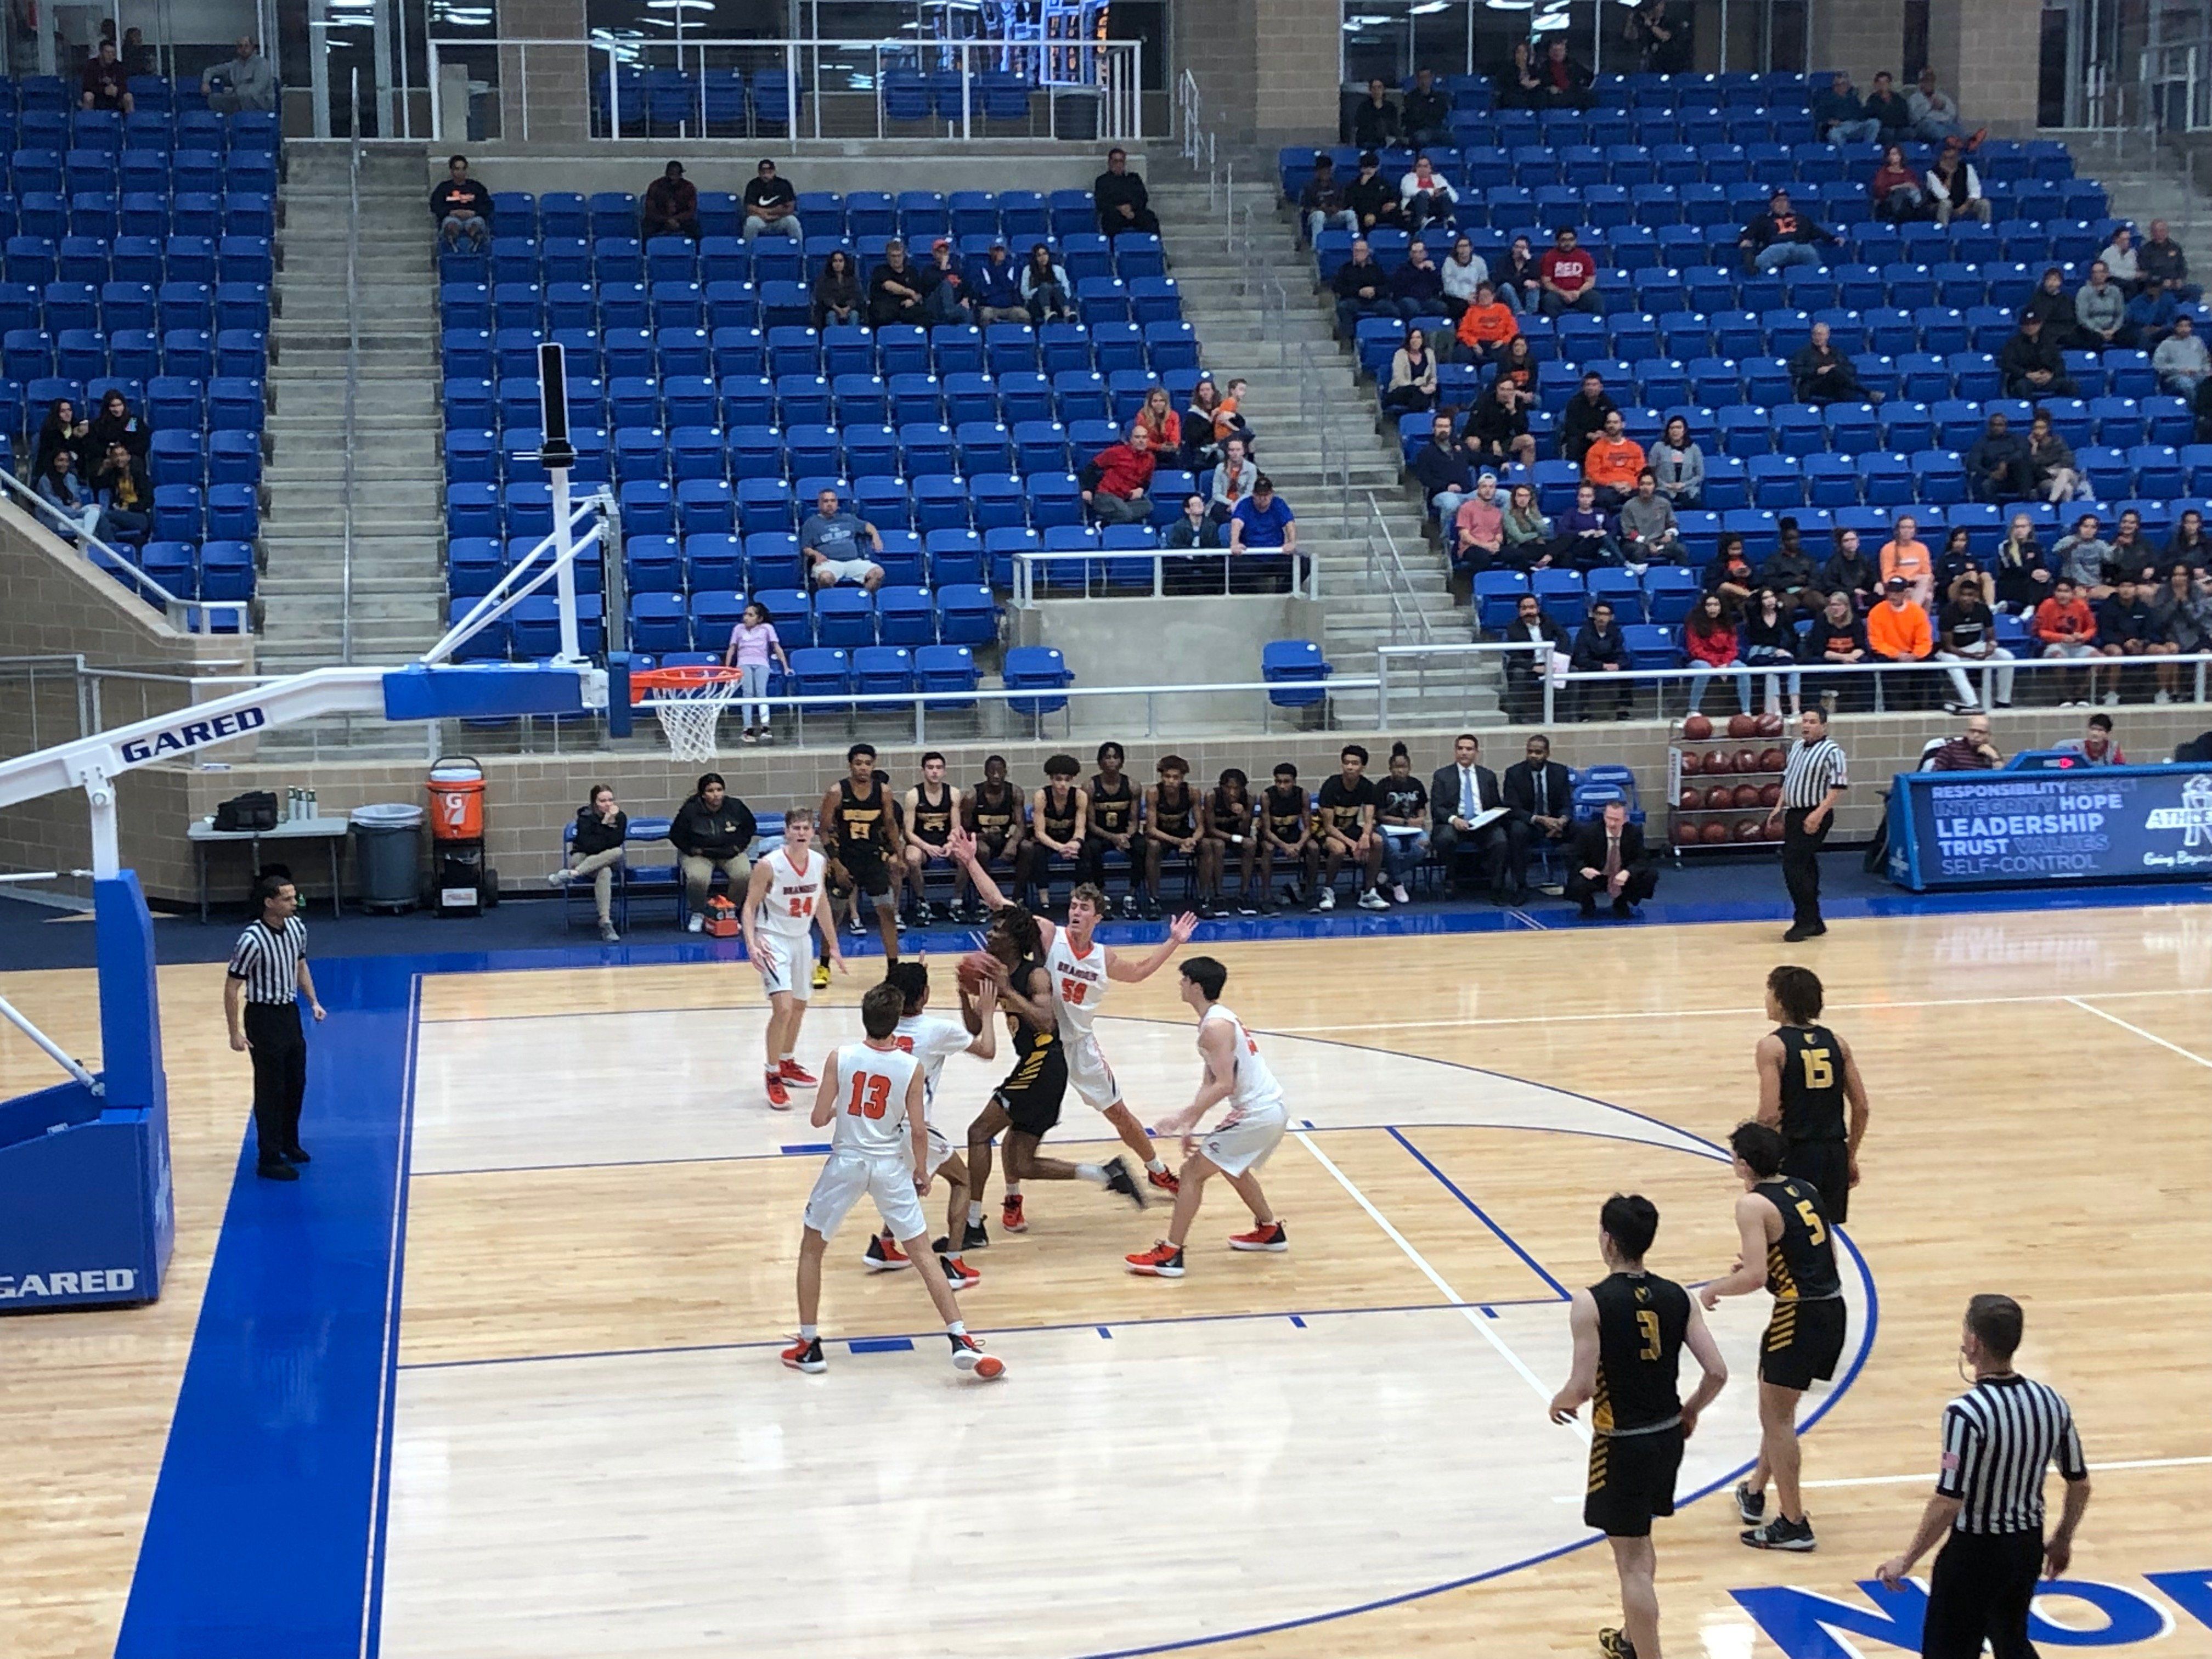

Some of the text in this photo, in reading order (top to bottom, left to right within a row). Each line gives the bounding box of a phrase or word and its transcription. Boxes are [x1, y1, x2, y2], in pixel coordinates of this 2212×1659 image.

[1555, 261, 1583, 278] RED
[121, 707, 266, 764] GARED
[1932, 777, 2137, 799] RESPONSIBILITY RESPECT
[445, 793, 462, 809] G
[1932, 793, 2124, 817] INTEGRITY HOPE
[1936, 812, 2105, 838] LEADERSHIP
[1938, 833, 2110, 856] TRUST VALUES
[1942, 853, 2101, 875] SELF-CONTROL
[789, 896, 812, 918] 24
[1799, 1047, 1833, 1089] 15
[847, 1070, 892, 1120] 13
[1795, 1199, 1826, 1246] 5
[1635, 1310, 1662, 1361] 3
